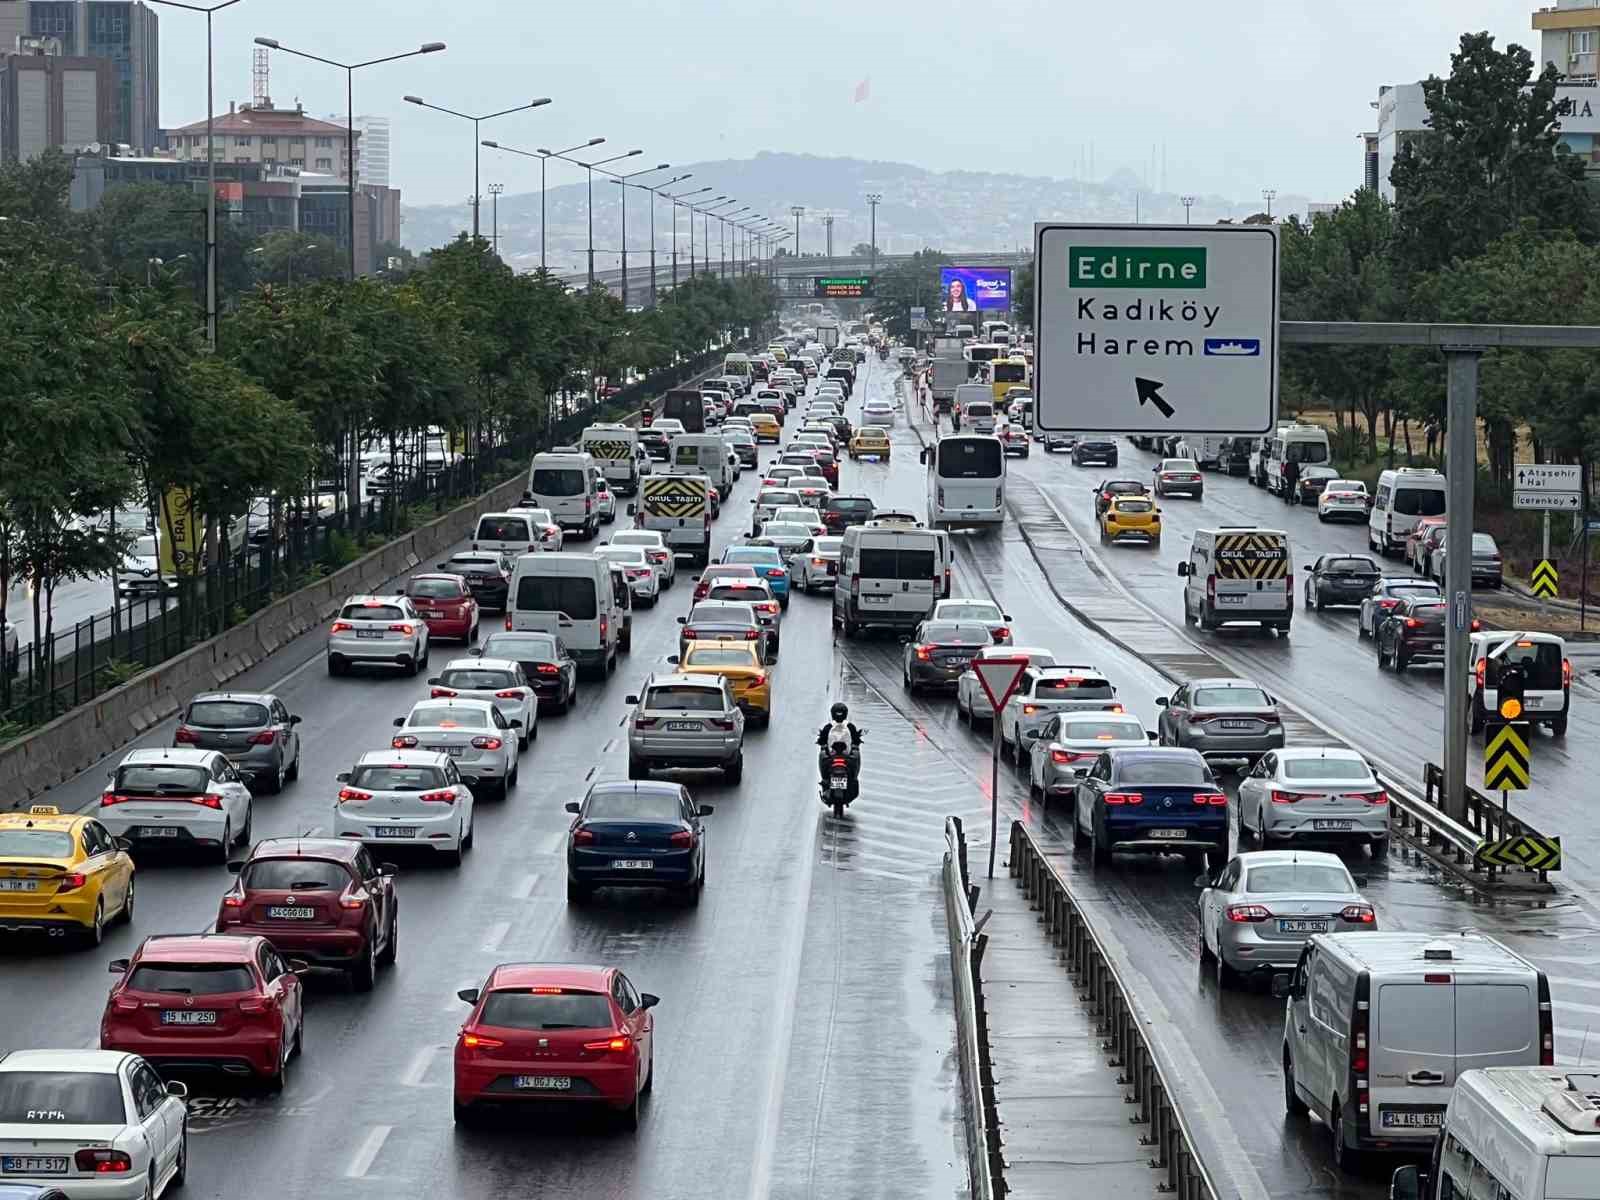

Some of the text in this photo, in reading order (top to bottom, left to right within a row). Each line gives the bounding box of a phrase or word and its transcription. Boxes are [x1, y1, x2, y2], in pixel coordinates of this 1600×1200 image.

[1078, 256, 1197, 280] Edirne
[1077, 298, 1220, 328] Kadıköy
[1077, 333, 1193, 355] Harem
[1220, 550, 1245, 558] OKUL
[167, 1012, 214, 1022] 15 NT 250
[519, 1078, 530, 1087] 34
[1390, 1114, 1400, 1123] 34
[9, 1158, 66, 1170] 58 FT 517
